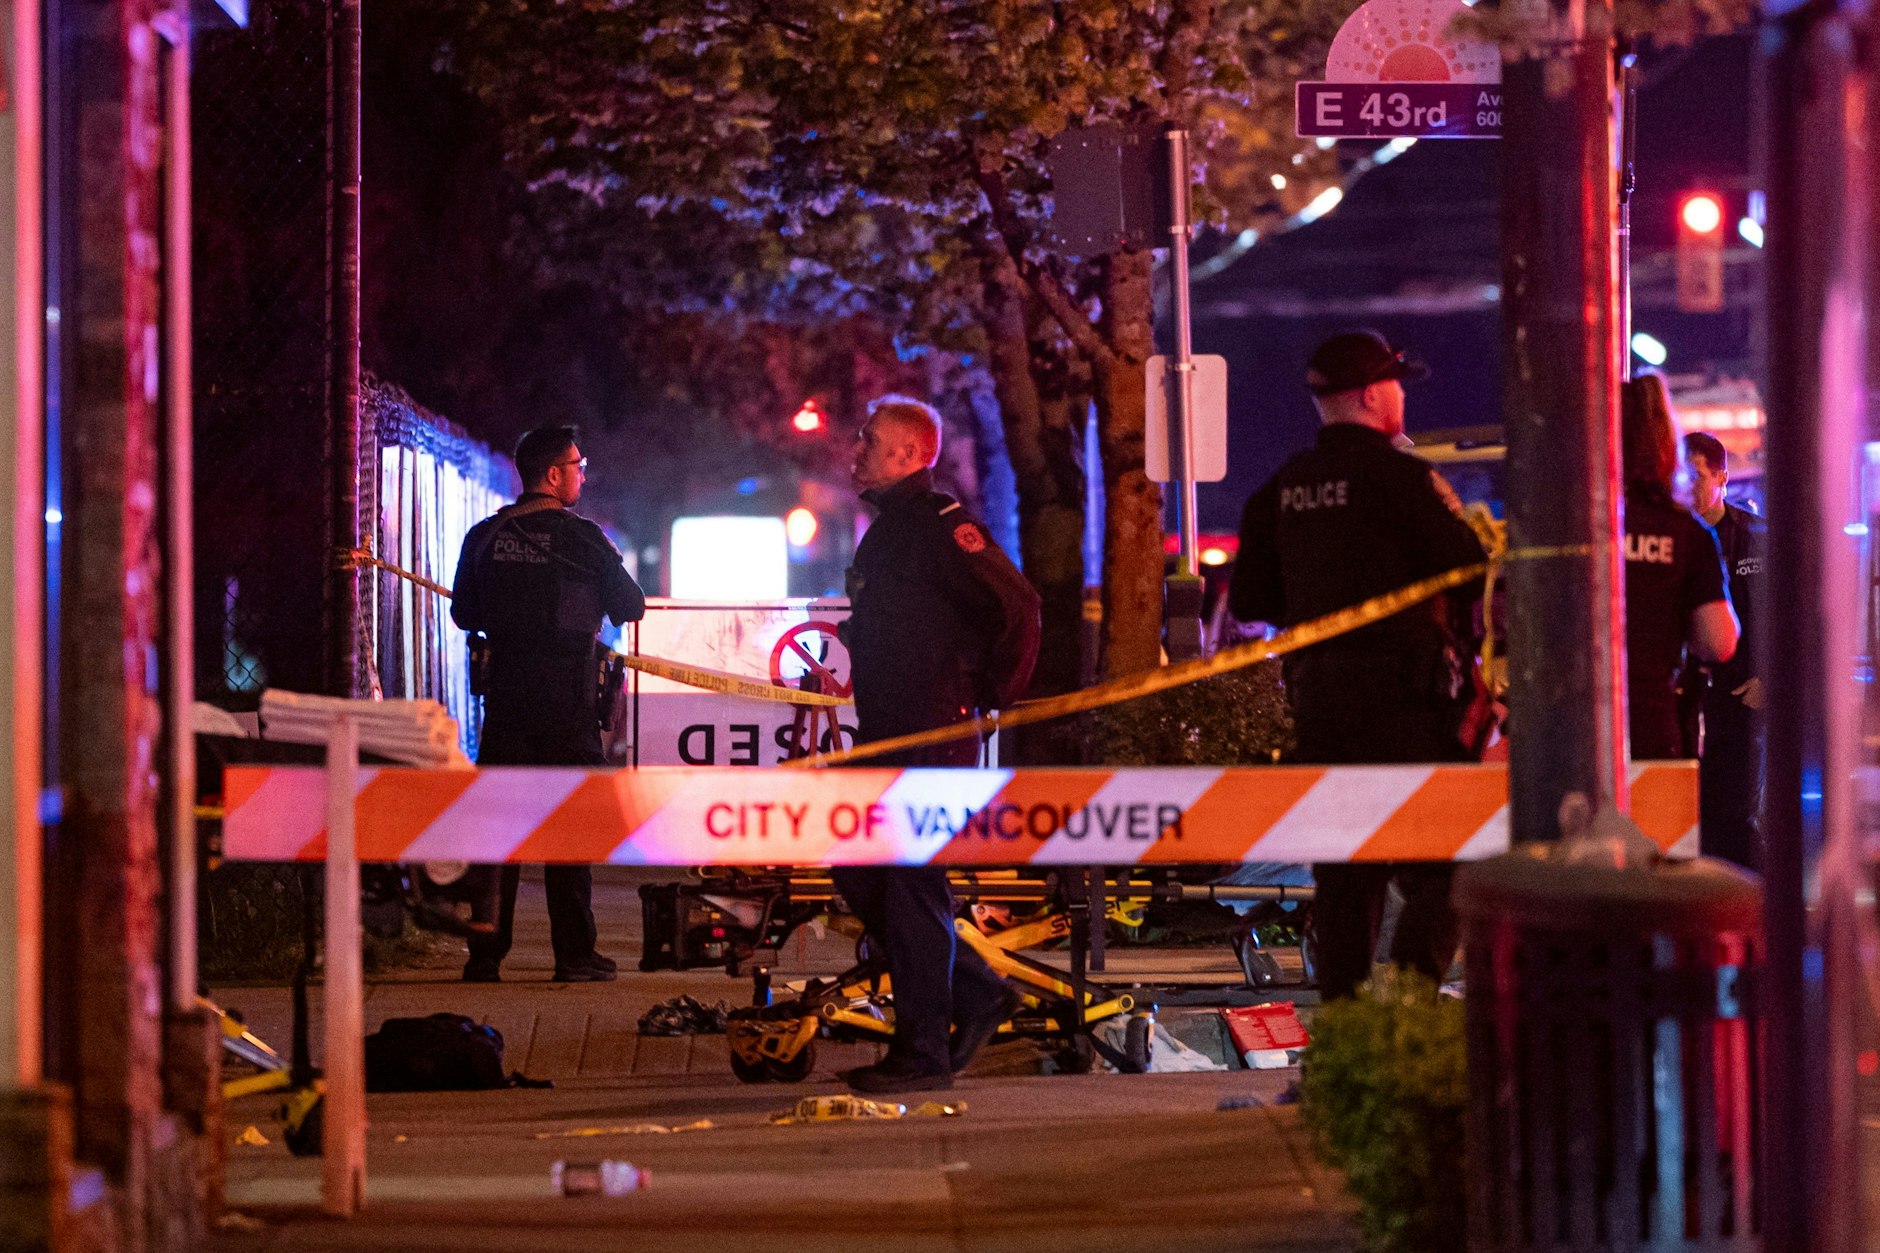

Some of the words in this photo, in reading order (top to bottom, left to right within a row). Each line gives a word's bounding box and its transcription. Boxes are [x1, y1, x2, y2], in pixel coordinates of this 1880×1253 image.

[1316, 92, 1343, 127] E
[1360, 92, 1447, 127] 43rd
[1477, 91, 1503, 106] Av
[1281, 481, 1348, 512] POLICE
[1626, 533, 1673, 564] LICE
[706, 803, 809, 839] CITY
[829, 803, 886, 840] OF
[907, 804, 1184, 842] VANCOUVER
